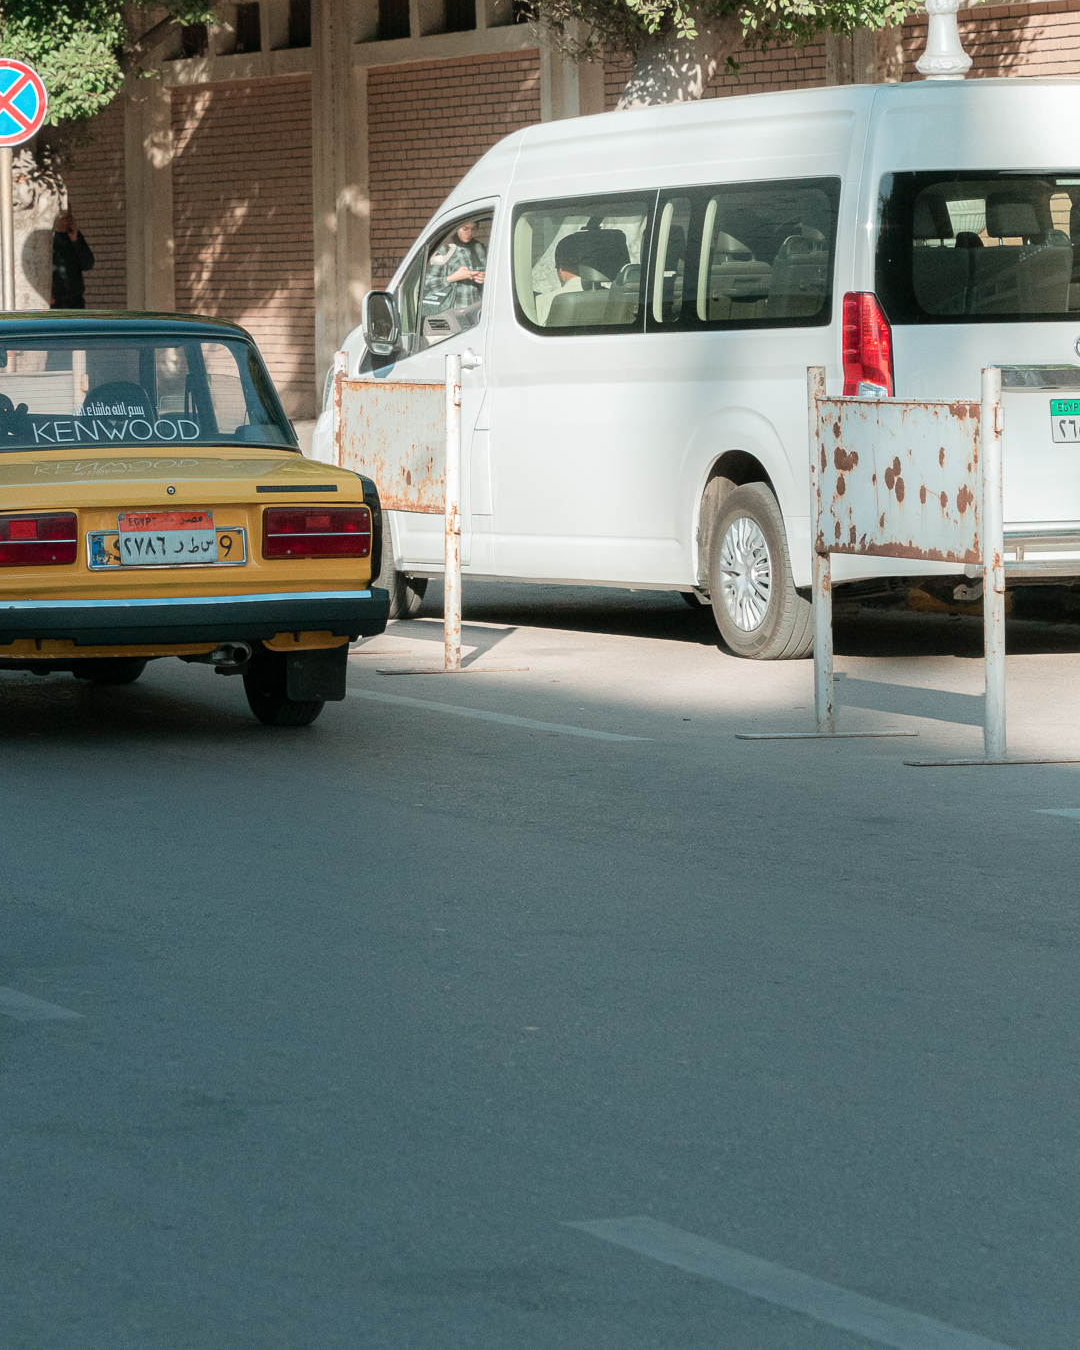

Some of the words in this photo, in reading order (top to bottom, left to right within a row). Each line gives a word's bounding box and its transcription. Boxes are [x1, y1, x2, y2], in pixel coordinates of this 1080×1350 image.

[112, 401, 127, 416] الله
[128, 404, 145, 417] بسم
[32, 419, 200, 443] KENWOOD
[1058, 419, 1080, 438] ٢٦
[128, 517, 156, 526] EGYPT
[180, 516, 203, 525] مصر
